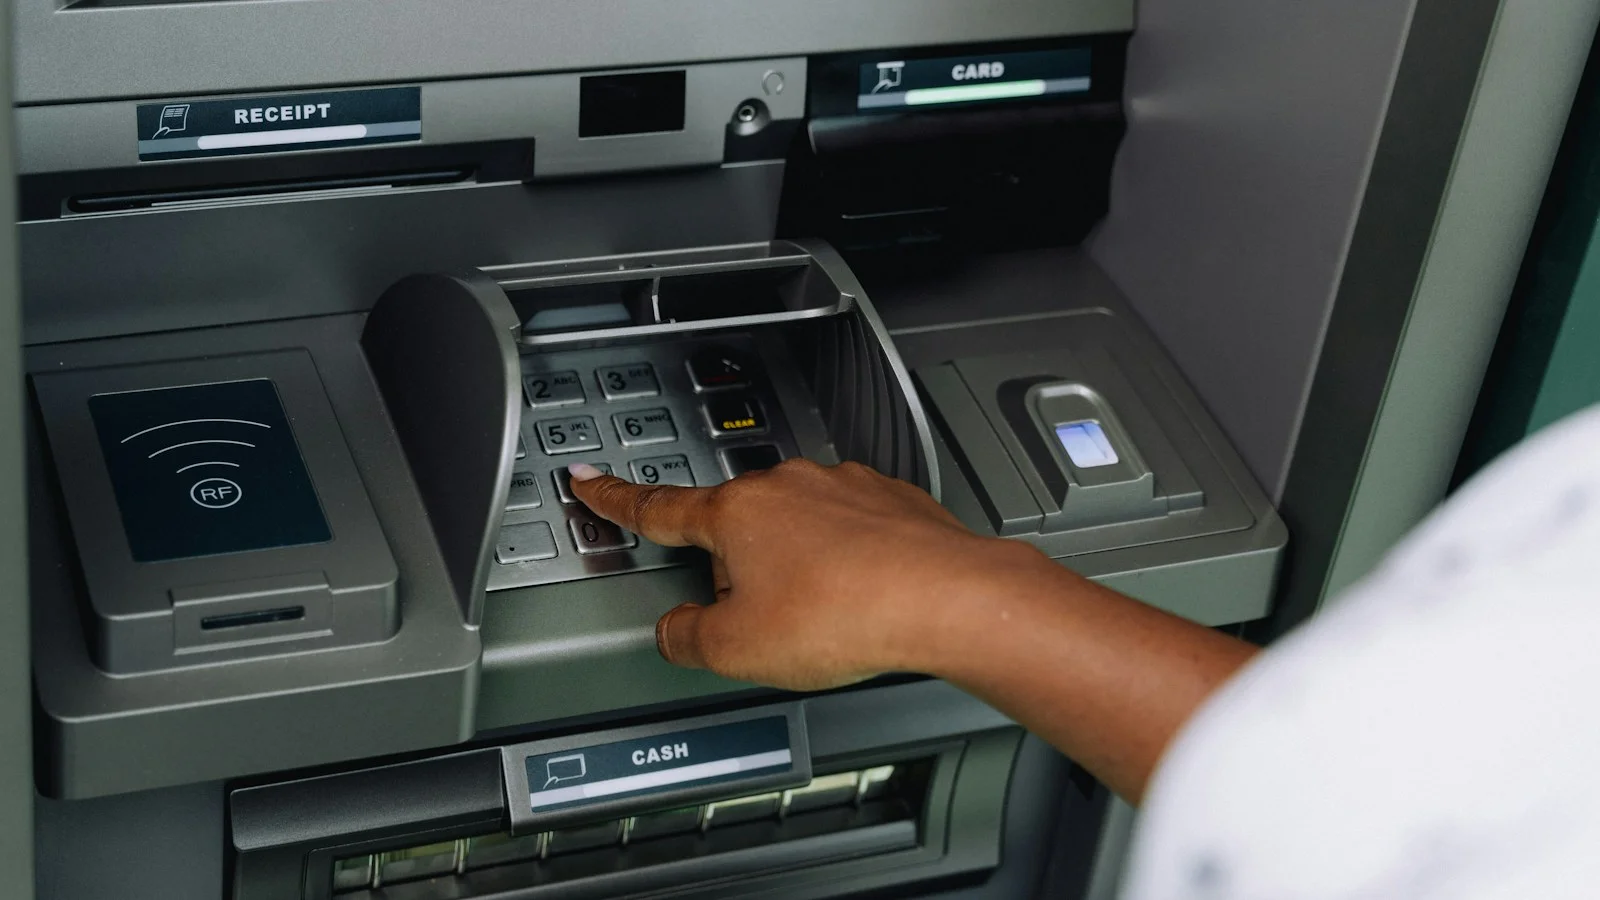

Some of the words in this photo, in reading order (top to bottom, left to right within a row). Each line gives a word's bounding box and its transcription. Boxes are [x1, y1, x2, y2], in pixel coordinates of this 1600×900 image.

[951, 61, 1005, 81] CARD
[234, 103, 331, 124] RECEIPT
[531, 379, 551, 399] 2
[553, 375, 577, 385] ABC
[607, 371, 626, 391] 3
[548, 425, 567, 445] 5
[570, 423, 590, 432] JKL
[624, 417, 643, 437] 6
[723, 418, 756, 429] CLEAR
[641, 464, 660, 484] 9
[661, 460, 687, 470] WXY
[200, 486, 233, 501] RF
[581, 521, 599, 543] 0
[632, 742, 689, 766] CASH
